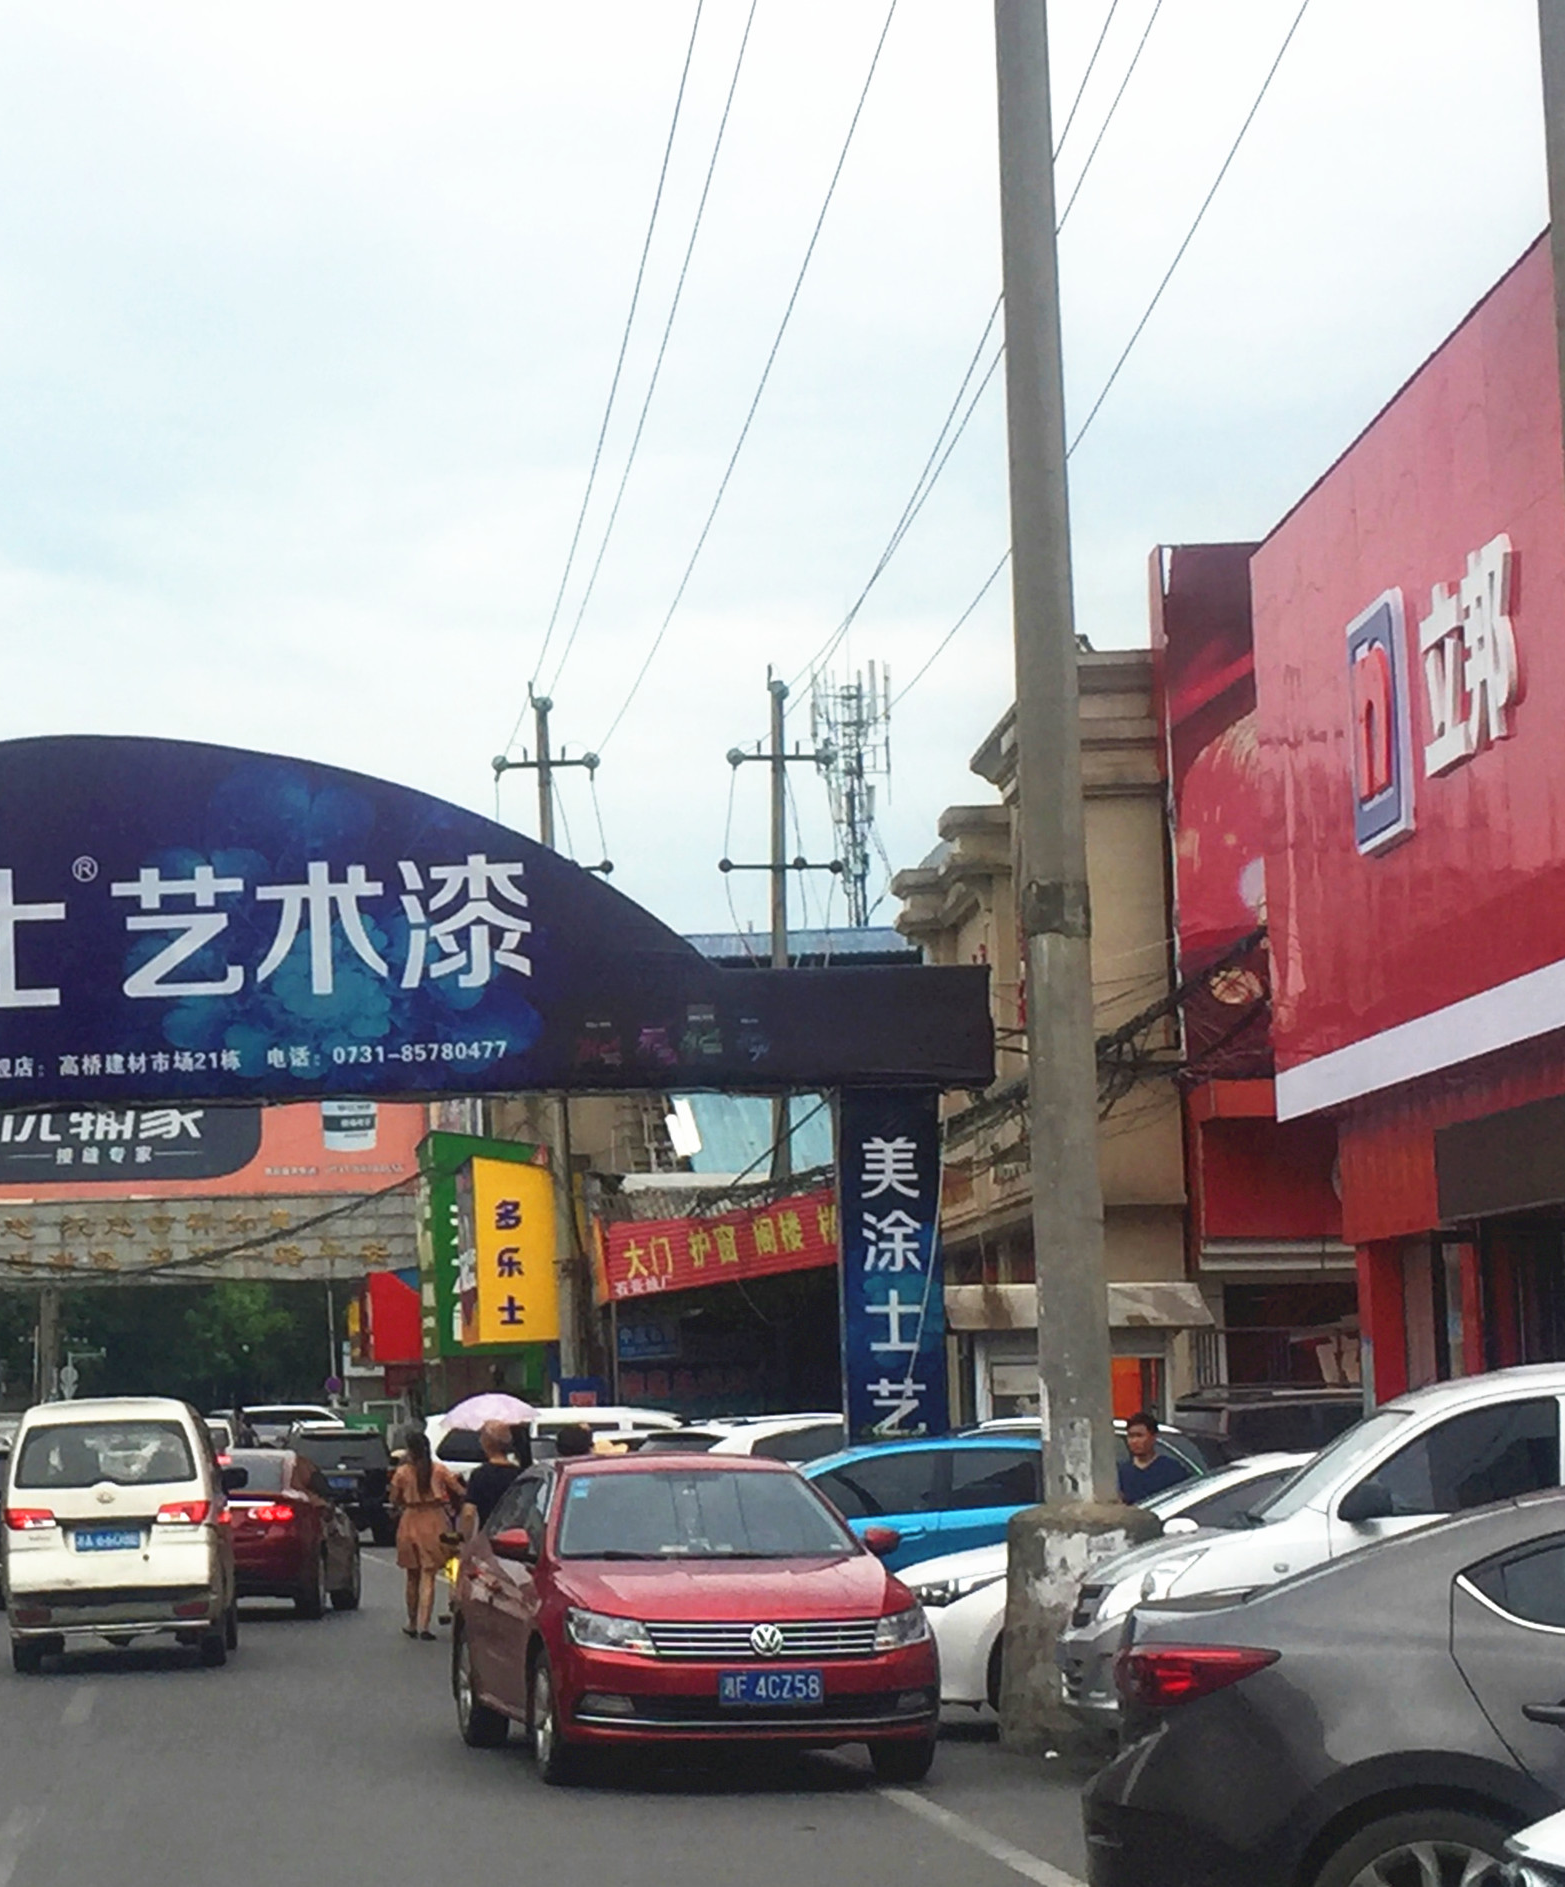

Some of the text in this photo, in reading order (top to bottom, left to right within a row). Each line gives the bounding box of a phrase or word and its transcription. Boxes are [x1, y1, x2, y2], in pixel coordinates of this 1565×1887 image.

[1419, 533, 1518, 778] 立邦
[111, 854, 532, 998] 艺术漆
[494, 1200, 526, 1325] 多乐士
[622, 1238, 674, 1279] 大门
[754, 1674, 821, 1699] 4CZ58
